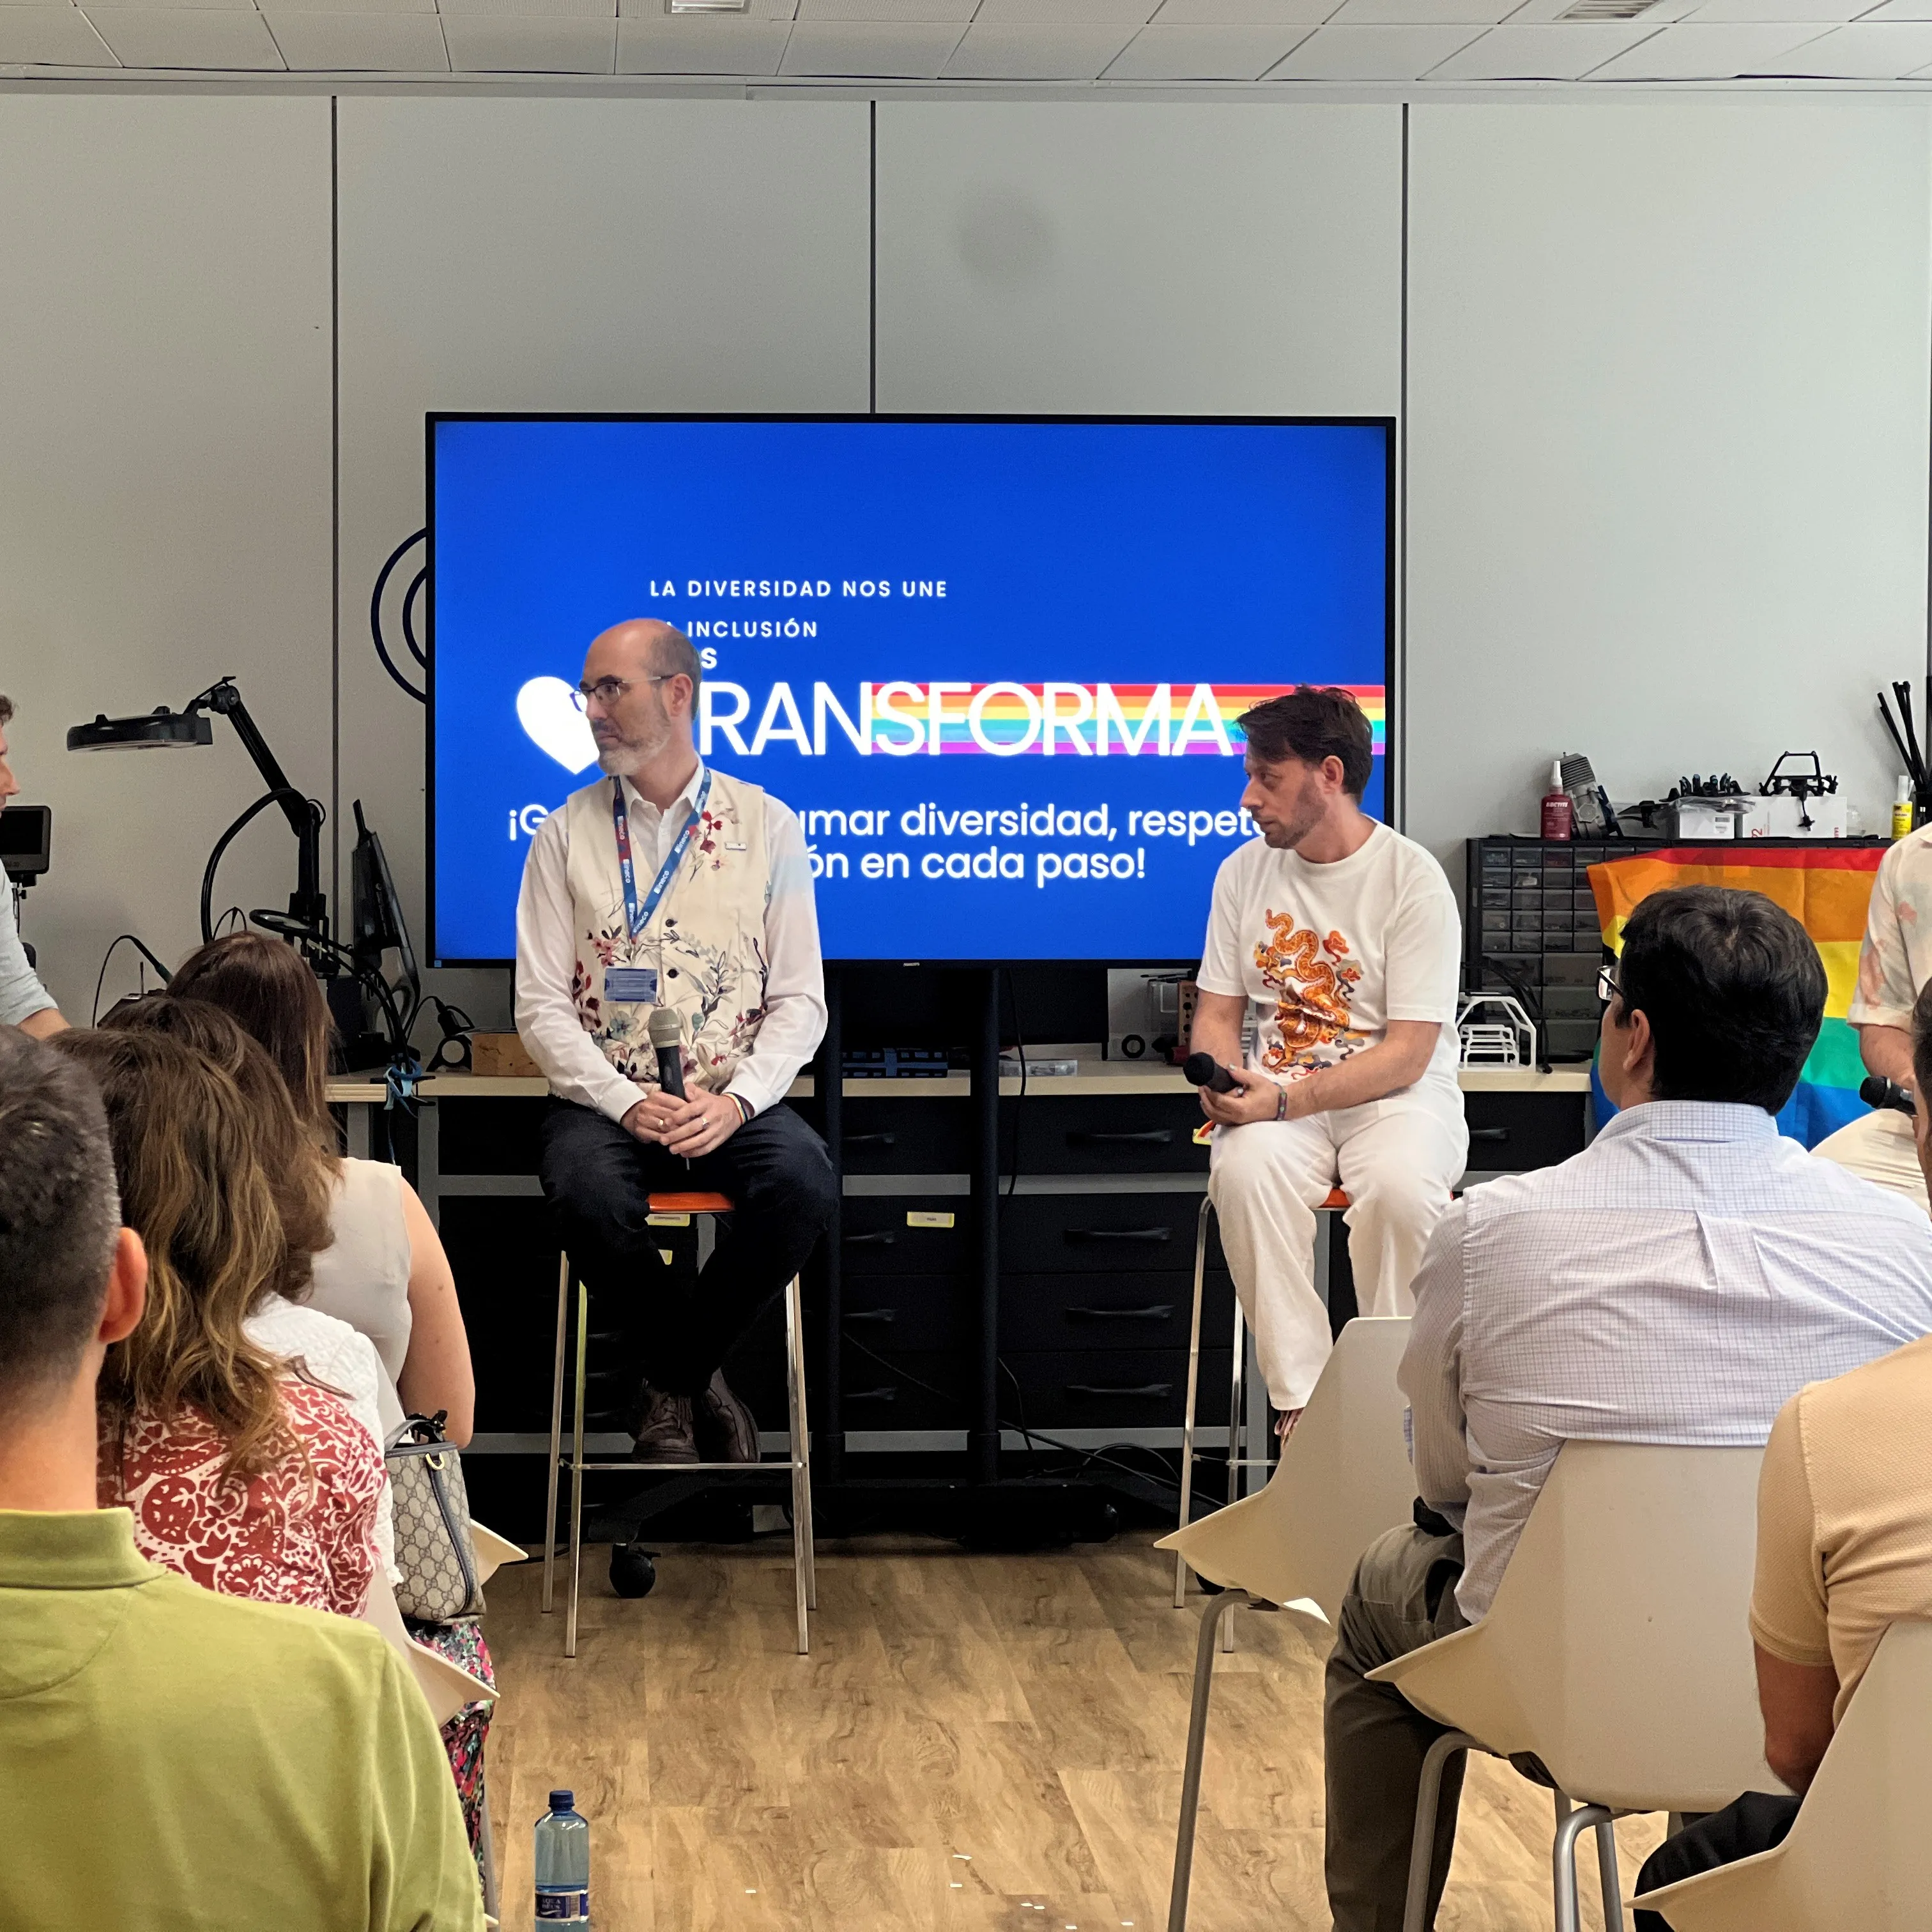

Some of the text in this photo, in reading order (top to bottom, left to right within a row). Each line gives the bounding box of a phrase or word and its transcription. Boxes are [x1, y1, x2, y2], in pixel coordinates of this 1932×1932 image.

[650, 580, 947, 597] LA DIVERSIDAD NOS UNE
[687, 618, 817, 638] INCLUSIÓN
[699, 681, 1234, 756] RANSFORMA
[901, 803, 1117, 841] diversidad,
[861, 853, 909, 878] en
[921, 846, 1025, 878] cada
[1038, 847, 1146, 889] paso!
